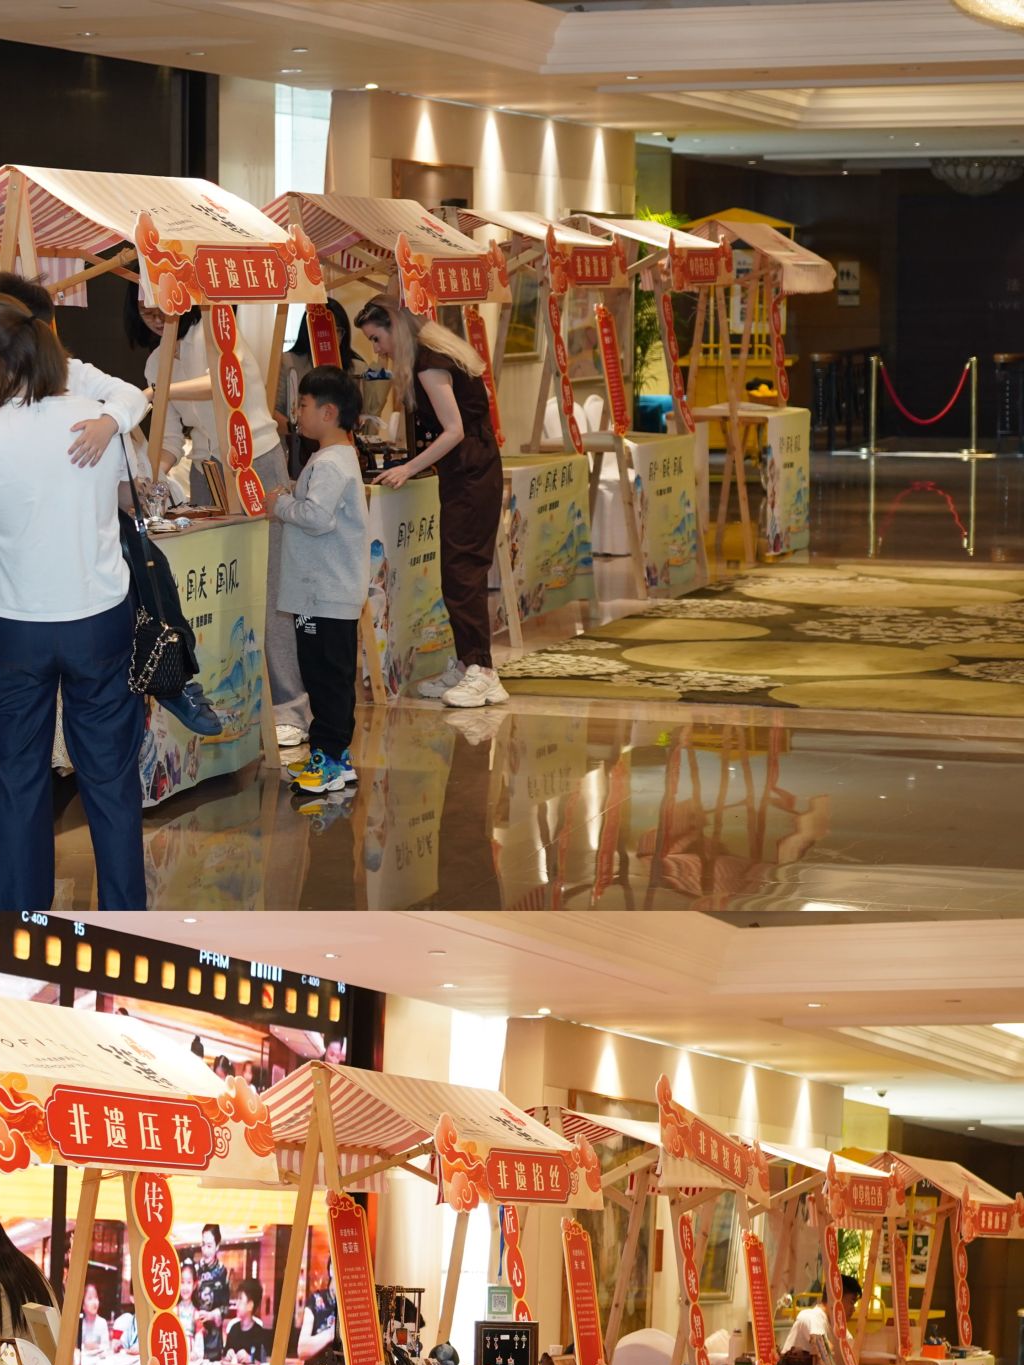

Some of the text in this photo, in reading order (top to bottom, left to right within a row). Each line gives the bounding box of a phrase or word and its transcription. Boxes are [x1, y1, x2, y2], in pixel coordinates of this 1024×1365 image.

[206, 257, 279, 289] 非遗压花
[217, 308, 263, 513] 传统智慧
[32, 911, 49, 927] 400
[73, 920, 86, 937] 15
[199, 950, 230, 970] PFRM
[337, 981, 346, 995] 16
[67, 1103, 195, 1155] 非遗压花
[497, 1160, 562, 1192] 非遗掐丝
